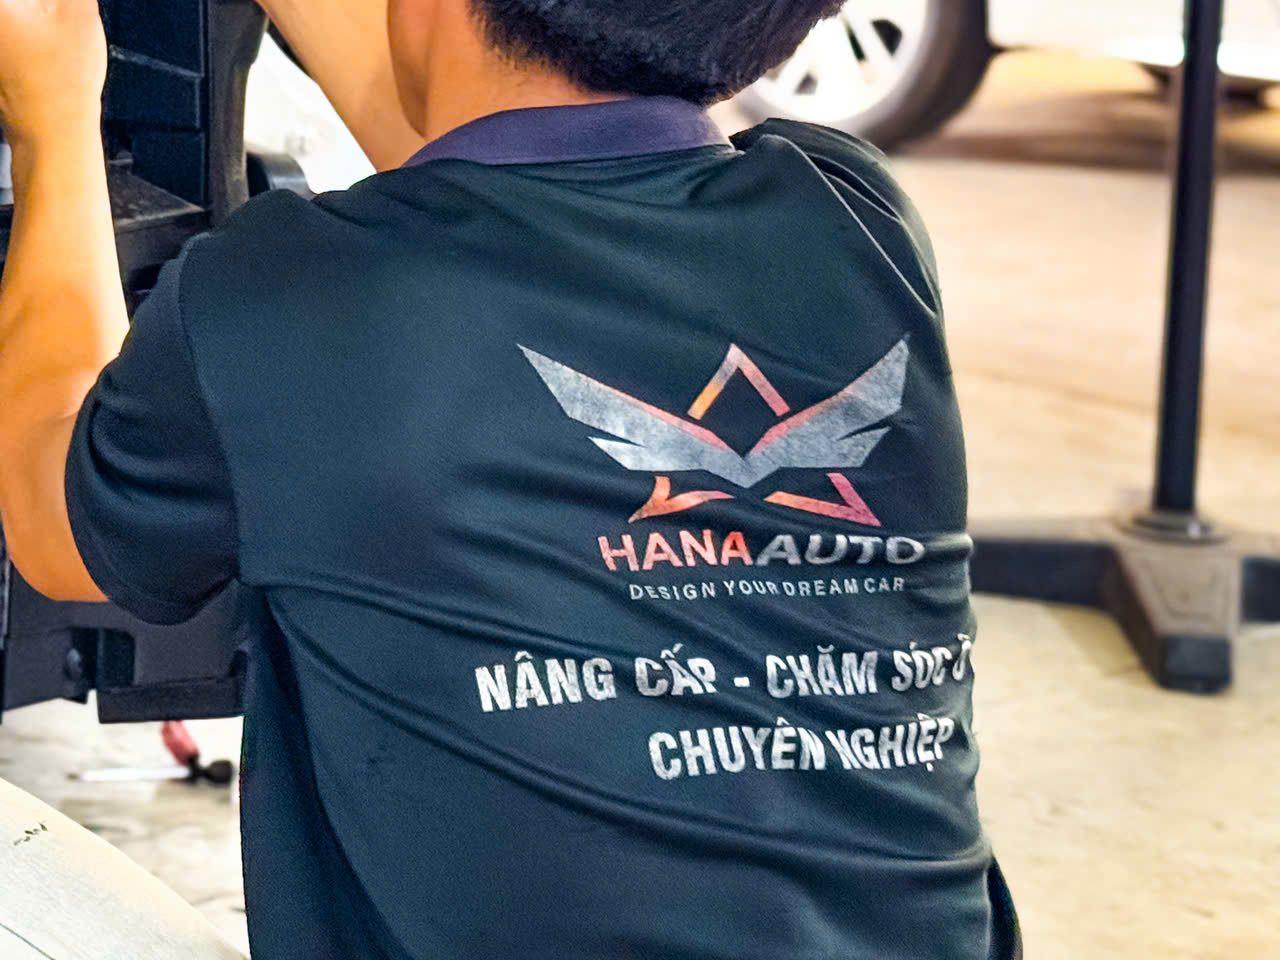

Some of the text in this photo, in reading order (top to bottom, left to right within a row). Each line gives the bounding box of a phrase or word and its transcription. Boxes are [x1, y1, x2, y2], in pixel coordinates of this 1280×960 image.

[629, 577, 905, 601] DESIGN YOUR DREAM CAR
[474, 650, 617, 712] NÂNG
[634, 642, 718, 697] CẤP
[765, 644, 879, 699] CHĂM
[648, 712, 955, 781] CHUYÊN NGHIỆP
